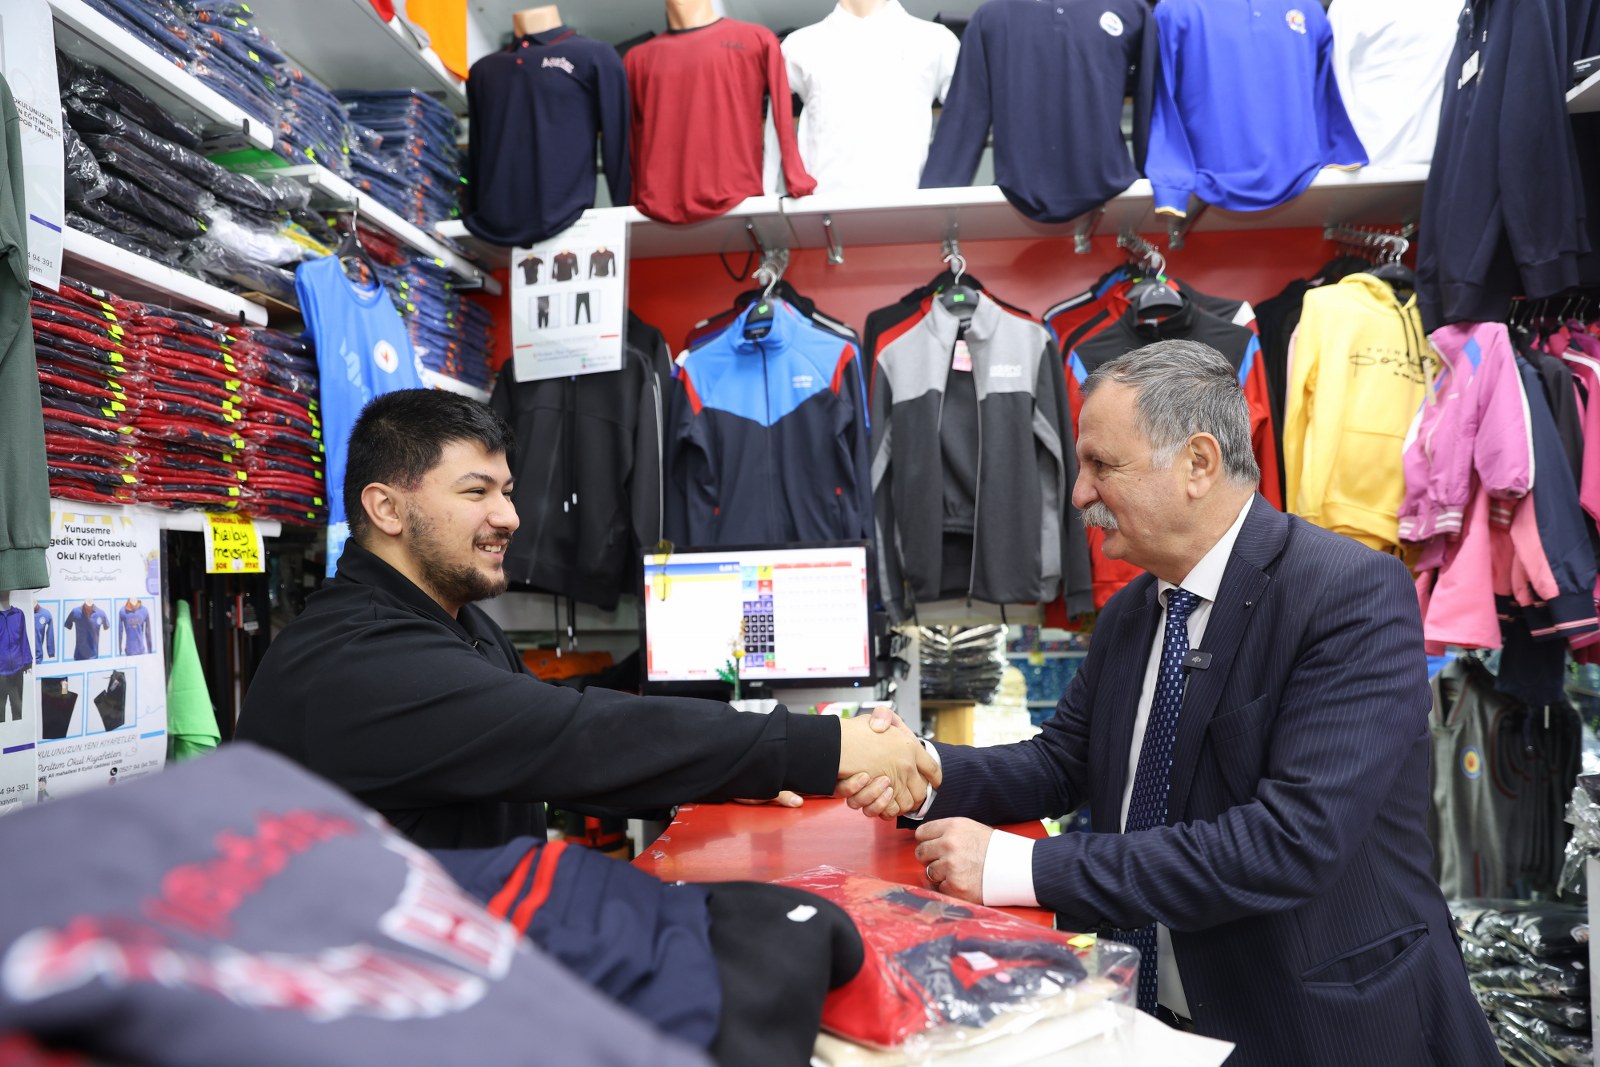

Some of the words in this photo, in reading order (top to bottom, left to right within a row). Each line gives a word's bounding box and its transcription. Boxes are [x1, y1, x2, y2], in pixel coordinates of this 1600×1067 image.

[42, 257, 53, 268] 391
[64, 524, 111, 535] Yunusemre
[76, 537, 96, 547] TOKİ
[98, 539, 137, 548] Ortaokulu
[56, 552, 77, 561] Okul
[79, 552, 122, 563] Kıyafetleri
[67, 757, 84, 767] Okul
[6, 786, 15, 794] 94
[17, 783, 30, 792] 391
